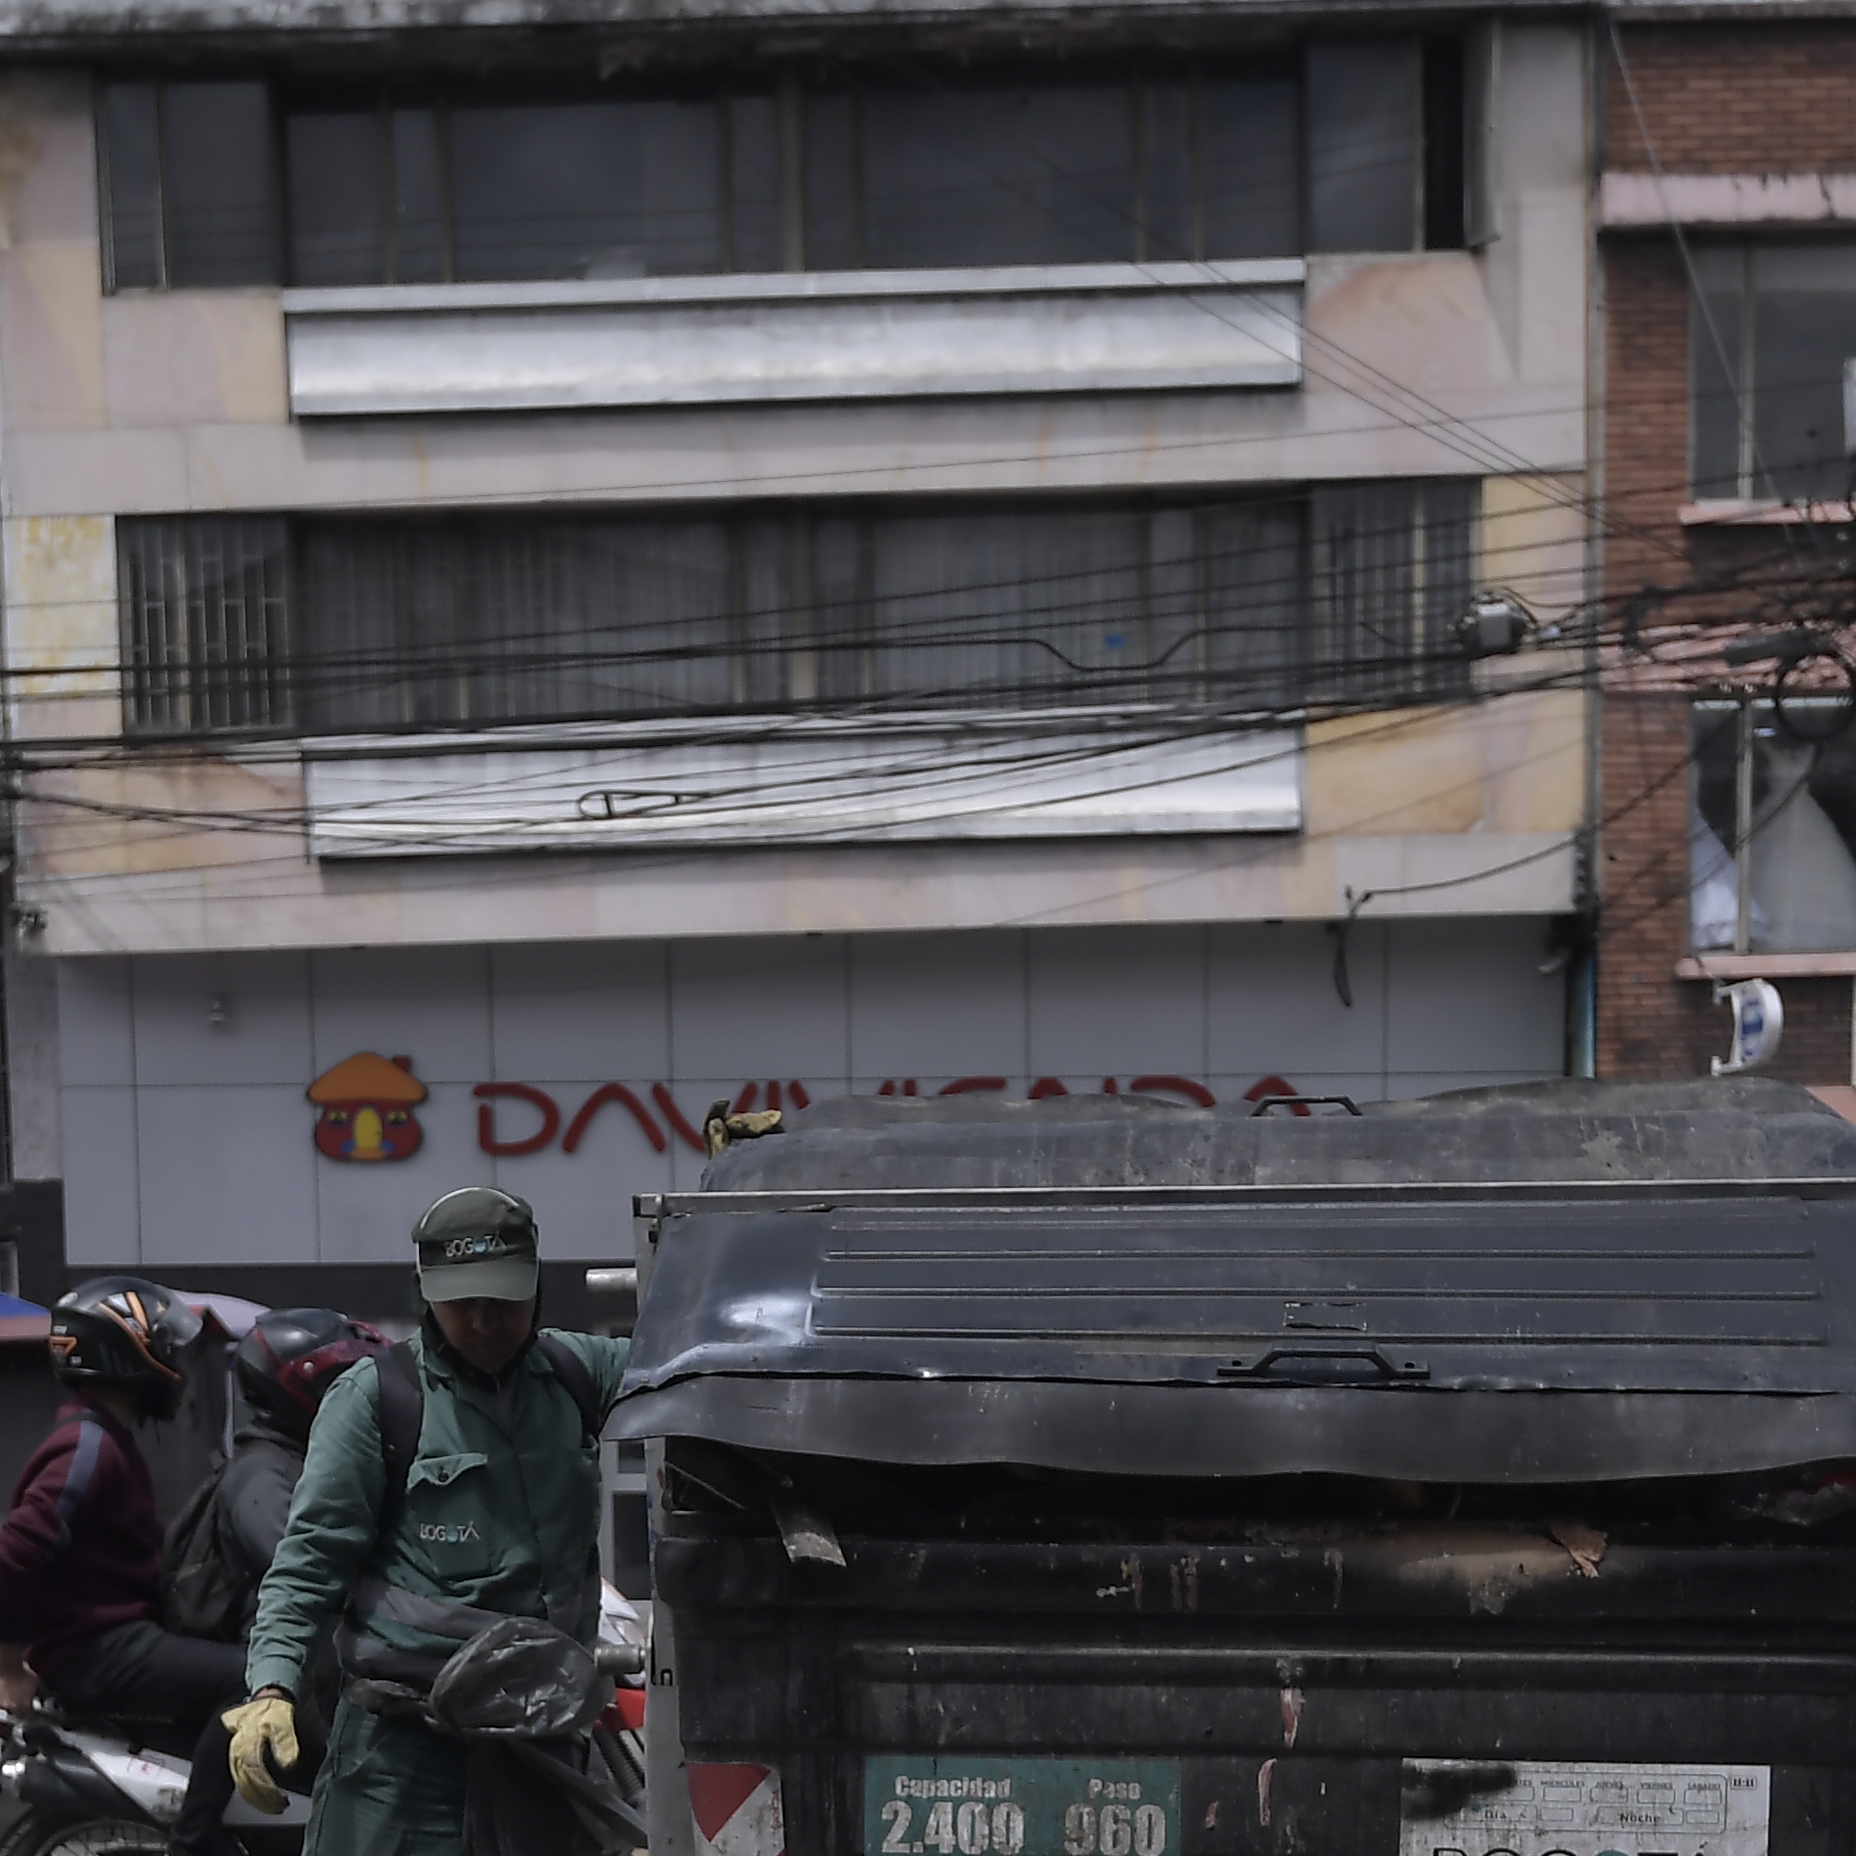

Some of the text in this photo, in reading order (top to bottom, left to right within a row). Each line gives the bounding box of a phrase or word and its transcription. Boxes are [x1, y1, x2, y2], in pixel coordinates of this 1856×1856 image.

[419, 1520, 482, 1543] BOGOTÁ
[895, 1775, 1011, 1798] Capacidad
[881, 1800, 1026, 1856] 2.400
